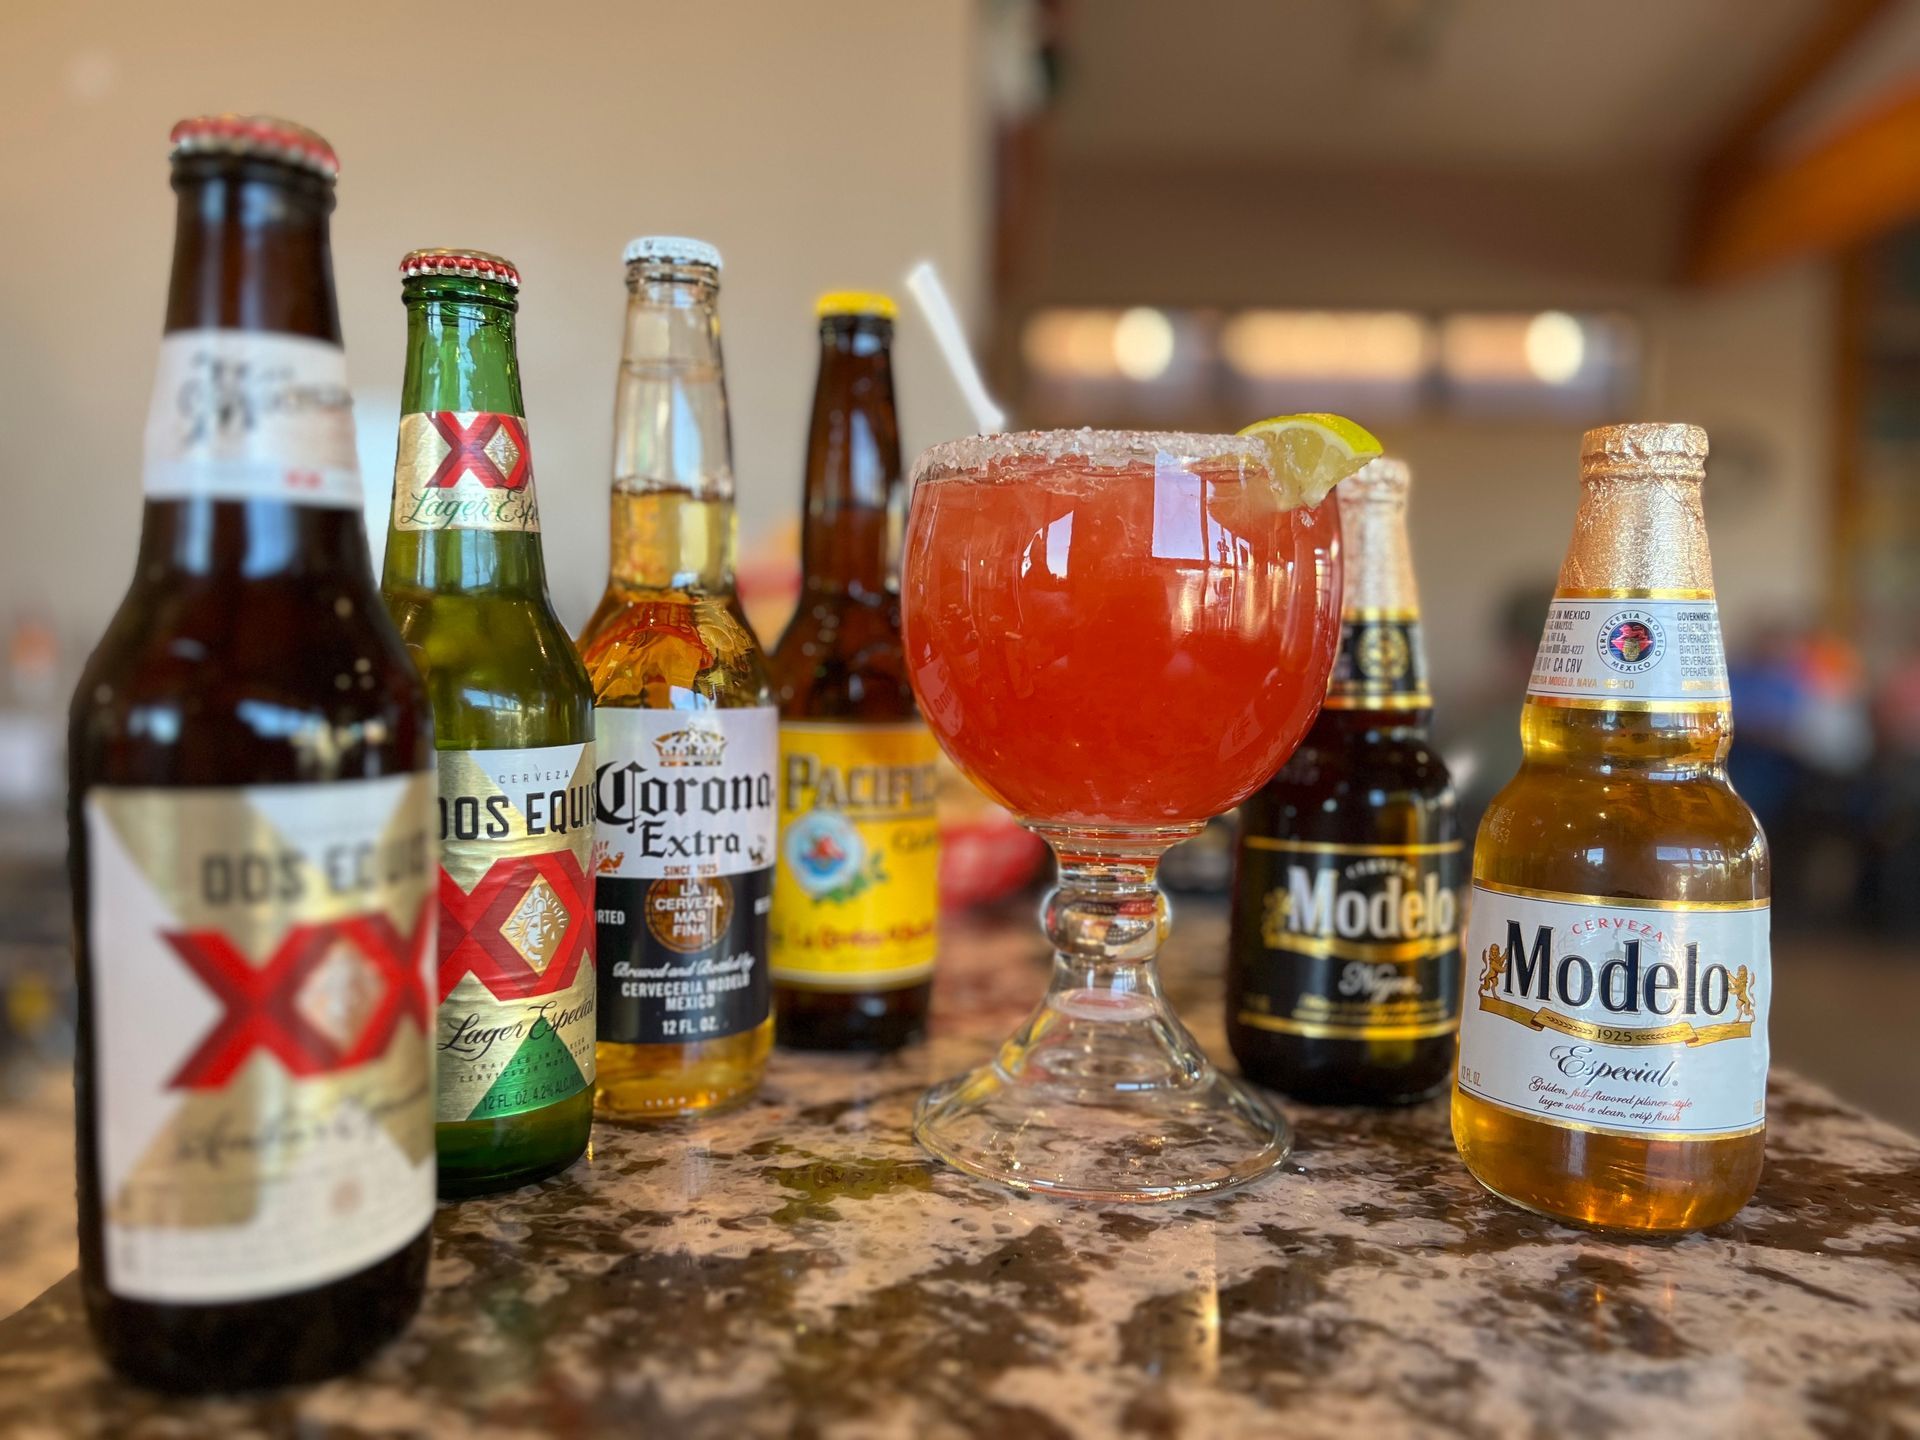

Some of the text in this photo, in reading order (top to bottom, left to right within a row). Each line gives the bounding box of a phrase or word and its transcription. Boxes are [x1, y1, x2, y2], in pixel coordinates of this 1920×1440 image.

[401, 485, 490, 529] Lager
[1563, 610, 1591, 620] MEXICO
[1600, 612, 1665, 657] CERVECERIA MODELO
[1680, 645, 1699, 654] BIRTH
[1553, 658, 1563, 672] CA
[1565, 658, 1582, 673] CRV
[1611, 661, 1651, 672] MEXICO
[1681, 667, 1707, 676] OPERATE
[499, 770, 570, 784] CERVEZA
[596, 761, 771, 834] Corona
[526, 781, 596, 836] EQUIS
[639, 820, 740, 858] Extra
[202, 851, 305, 906] DOS
[664, 865, 690, 876] SINCE
[680, 885, 700, 896] LA
[655, 896, 724, 911] CERVEZA
[1288, 865, 1456, 939] Modelo
[596, 911, 625, 925] RTED
[672, 924, 707, 938] FINA
[1571, 917, 1664, 943] CERVEZA
[1503, 920, 1729, 1016] Modelo
[622, 972, 750, 998] CERVECERIA MODELO
[665, 993, 716, 1012] MEXICO
[437, 995, 595, 1062] Lager Especial
[662, 1016, 720, 1036] 12 FL. OZ.
[1597, 1026, 1633, 1043] 1925
[1550, 1045, 1675, 1087] Especial
[483, 1096, 495, 1111] 12
[499, 1093, 512, 1108] FL.
[1529, 1076, 1693, 1112] Golden, full-flavored pilsner-style
[1538, 1095, 1564, 1110] lager
[1565, 1101, 1585, 1112] with
[1597, 1107, 1627, 1118] clean,
[1630, 1110, 1653, 1124] crisp
[1653, 1110, 1681, 1126] finish
